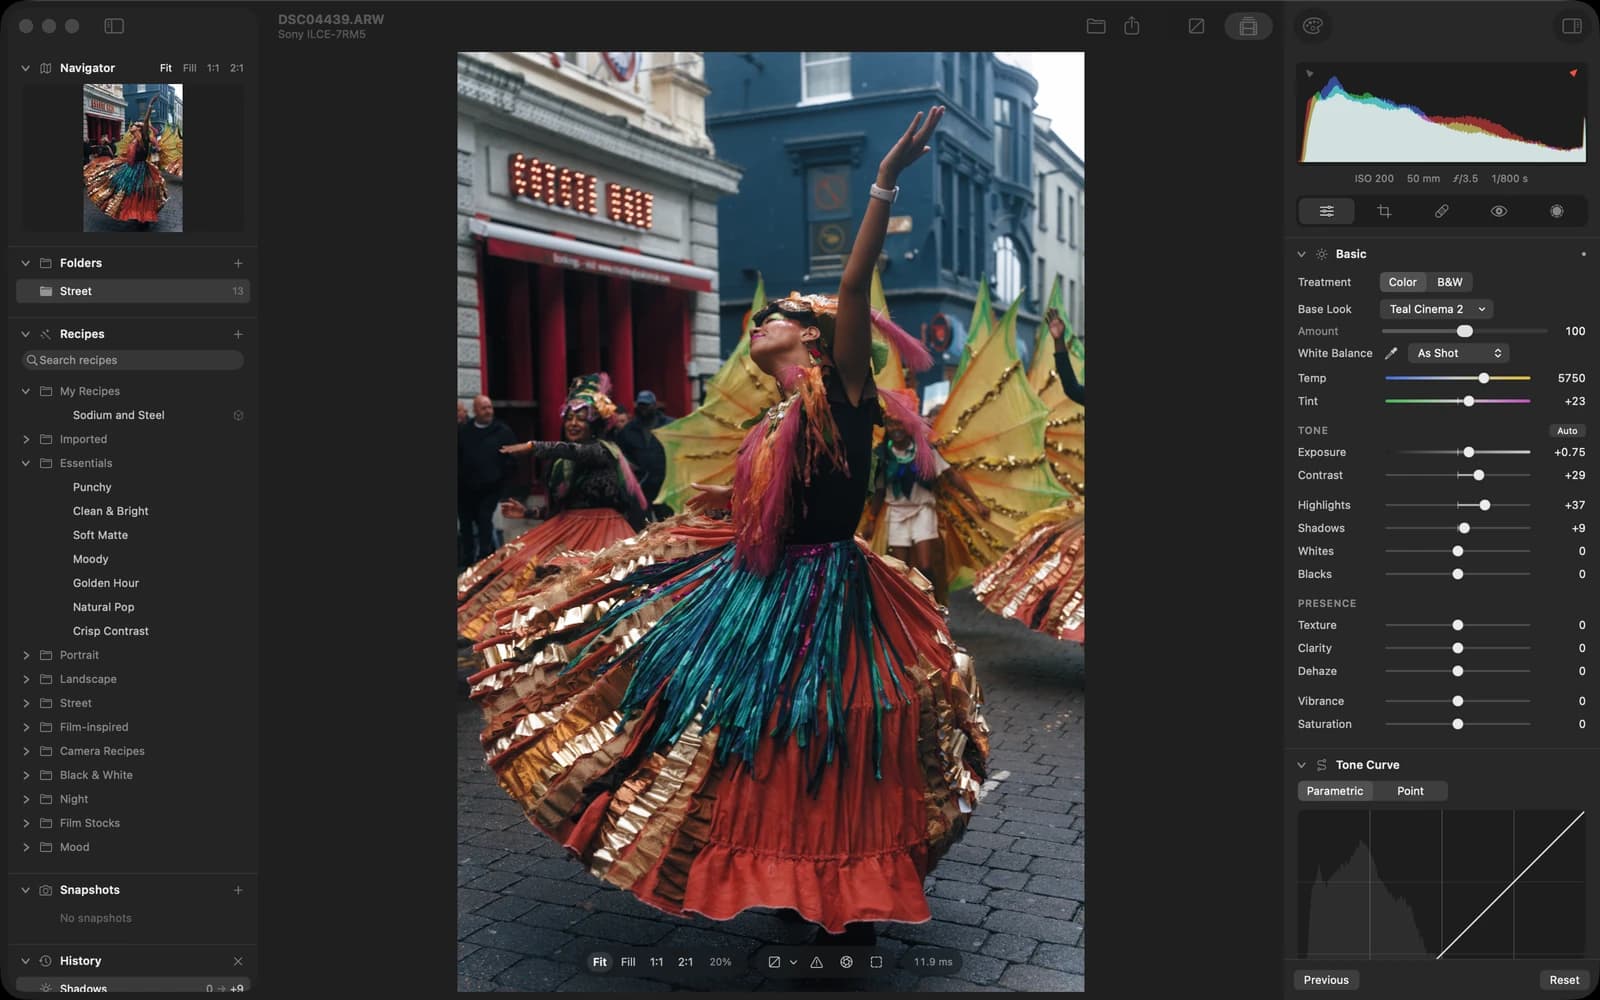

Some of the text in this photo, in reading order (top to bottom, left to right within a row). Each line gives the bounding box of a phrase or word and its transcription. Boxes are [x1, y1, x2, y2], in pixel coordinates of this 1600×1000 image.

[278, 13, 385, 25] DSC04439.ARW
[277, 28, 367, 41] Sony ILCE-7RM5
[60, 62, 116, 75] Navigator
[159, 63, 244, 73] Fit Fill 1:1 2:1
[1354, 173, 1373, 183] ISO
[1375, 173, 1395, 184] 200
[1407, 173, 1420, 184] 50
[1422, 175, 1441, 183] mm
[1491, 173, 1520, 185] 1/800
[1522, 175, 1529, 183] s
[1336, 248, 1367, 259] Basic
[60, 257, 103, 268] Folders
[1297, 277, 1352, 287] Treatment
[1388, 276, 1418, 287] Color
[1437, 277, 1464, 287] B&W
[60, 286, 93, 296] Street
[232, 286, 245, 296] 13
[1297, 304, 1353, 314] Base Look
[1389, 303, 1464, 314] Teal Cinema 2
[60, 328, 105, 341] Recipes
[1297, 326, 1339, 336] Amount
[1565, 326, 1586, 336] 100
[1297, 347, 1373, 359] White Balance
[1417, 347, 1459, 358] As Shot
[39, 354, 118, 367] Search recipes
[1297, 373, 1327, 385] Temp
[1558, 373, 1586, 383] 5750
[60, 385, 121, 398] My Recipes
[1297, 395, 1319, 406] Tint
[1564, 396, 1586, 406] +23
[72, 409, 165, 420] Sodium and Steel
[1297, 425, 1329, 435] TONE
[1557, 426, 1578, 435] Auto
[60, 434, 108, 446] Imported
[1298, 447, 1347, 459] Exposure
[1554, 447, 1586, 457] +0.75
[60, 457, 113, 468] Essentials
[1297, 470, 1344, 480] Contrast
[1564, 470, 1586, 480] +29
[73, 482, 112, 494] Punchy
[1297, 499, 1351, 512] Highlights
[1564, 500, 1586, 510] +37
[72, 505, 149, 518] Clean & Bright
[1297, 522, 1346, 533] Shadows
[1571, 523, 1586, 533] +9
[72, 529, 129, 540] Soft Matte
[1297, 545, 1335, 556] Whites
[1578, 546, 1586, 556] 0
[73, 553, 109, 566] Moody
[1297, 568, 1333, 579] Blacks
[1578, 569, 1586, 579] 0
[72, 577, 140, 588] Golden Hour
[73, 601, 135, 614] Natural Pop
[1297, 598, 1357, 608] PRESENCE
[1297, 620, 1337, 630] Texture
[1578, 620, 1586, 630] 0
[72, 625, 150, 638] Crisp Contrast
[1297, 642, 1333, 655] Clarity
[1578, 643, 1586, 653] 0
[59, 649, 100, 660] Portrait
[1297, 665, 1338, 676] Dehaze
[1578, 666, 1586, 676] 0
[60, 673, 118, 686] Landscape
[59, 698, 92, 708] Street
[1297, 695, 1345, 706] Vibrance
[1578, 695, 1586, 706] 0
[60, 721, 129, 734] Film-inspired
[1297, 719, 1352, 729] Saturation
[1578, 719, 1586, 729] 0
[59, 745, 145, 758] Camera Recipes
[1335, 759, 1400, 770] Tone Curve
[60, 769, 134, 780] Black & White
[1307, 785, 1364, 796] Parametric
[1397, 785, 1425, 796] Point
[60, 793, 89, 806] Night
[60, 817, 121, 828] Film Stocks
[60, 841, 90, 852] Mood
[60, 884, 121, 897] Snapshots
[59, 912, 133, 925] No snapshots
[60, 955, 102, 968] History
[593, 956, 732, 967] Fit Fill 1:1 2:1 20%
[914, 957, 953, 967] 11.9 ms
[1304, 974, 1350, 985] Previous
[1550, 975, 1580, 985] Reset
[60, 983, 108, 992] Shadows
[206, 983, 244, 992] 0 +9
